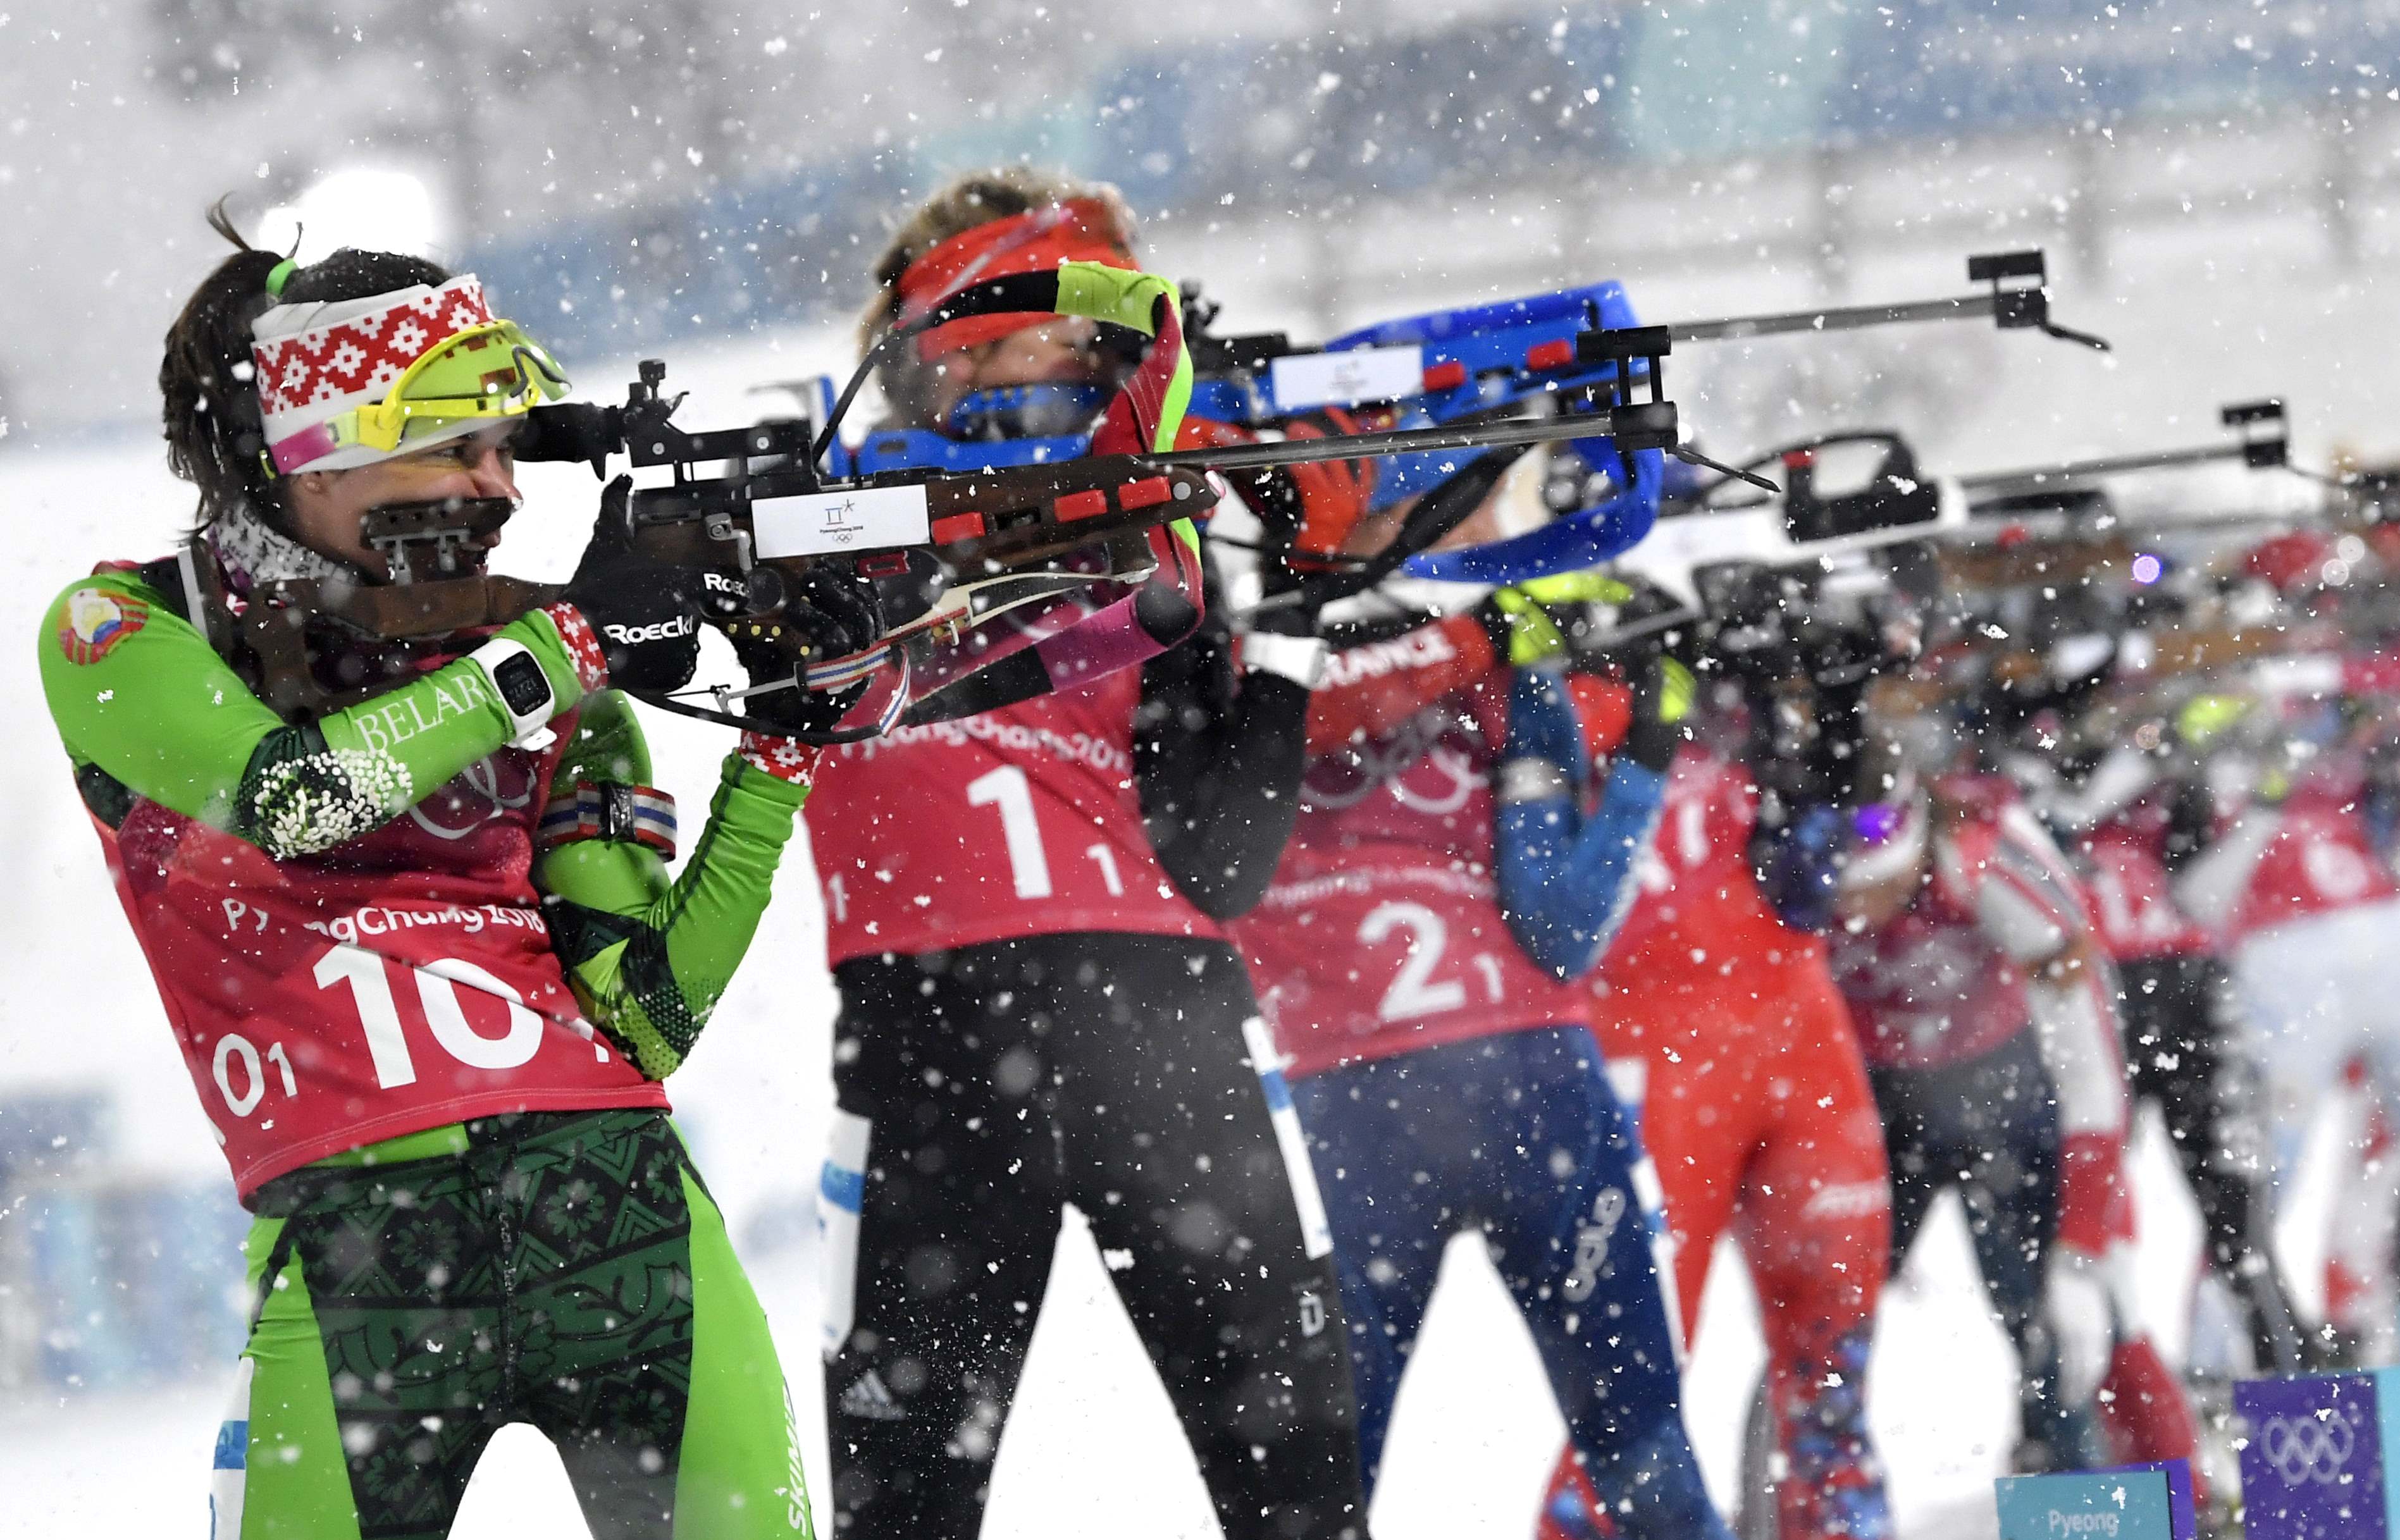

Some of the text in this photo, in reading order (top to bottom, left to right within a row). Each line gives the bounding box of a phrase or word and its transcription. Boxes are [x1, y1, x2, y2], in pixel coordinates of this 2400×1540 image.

[353, 674, 486, 759] BELAR
[966, 764, 1123, 899] 1 1
[312, 945, 544, 1090] 10
[1357, 901, 1504, 1022] 2 1
[2049, 1509, 2119, 1538] Pyeong
